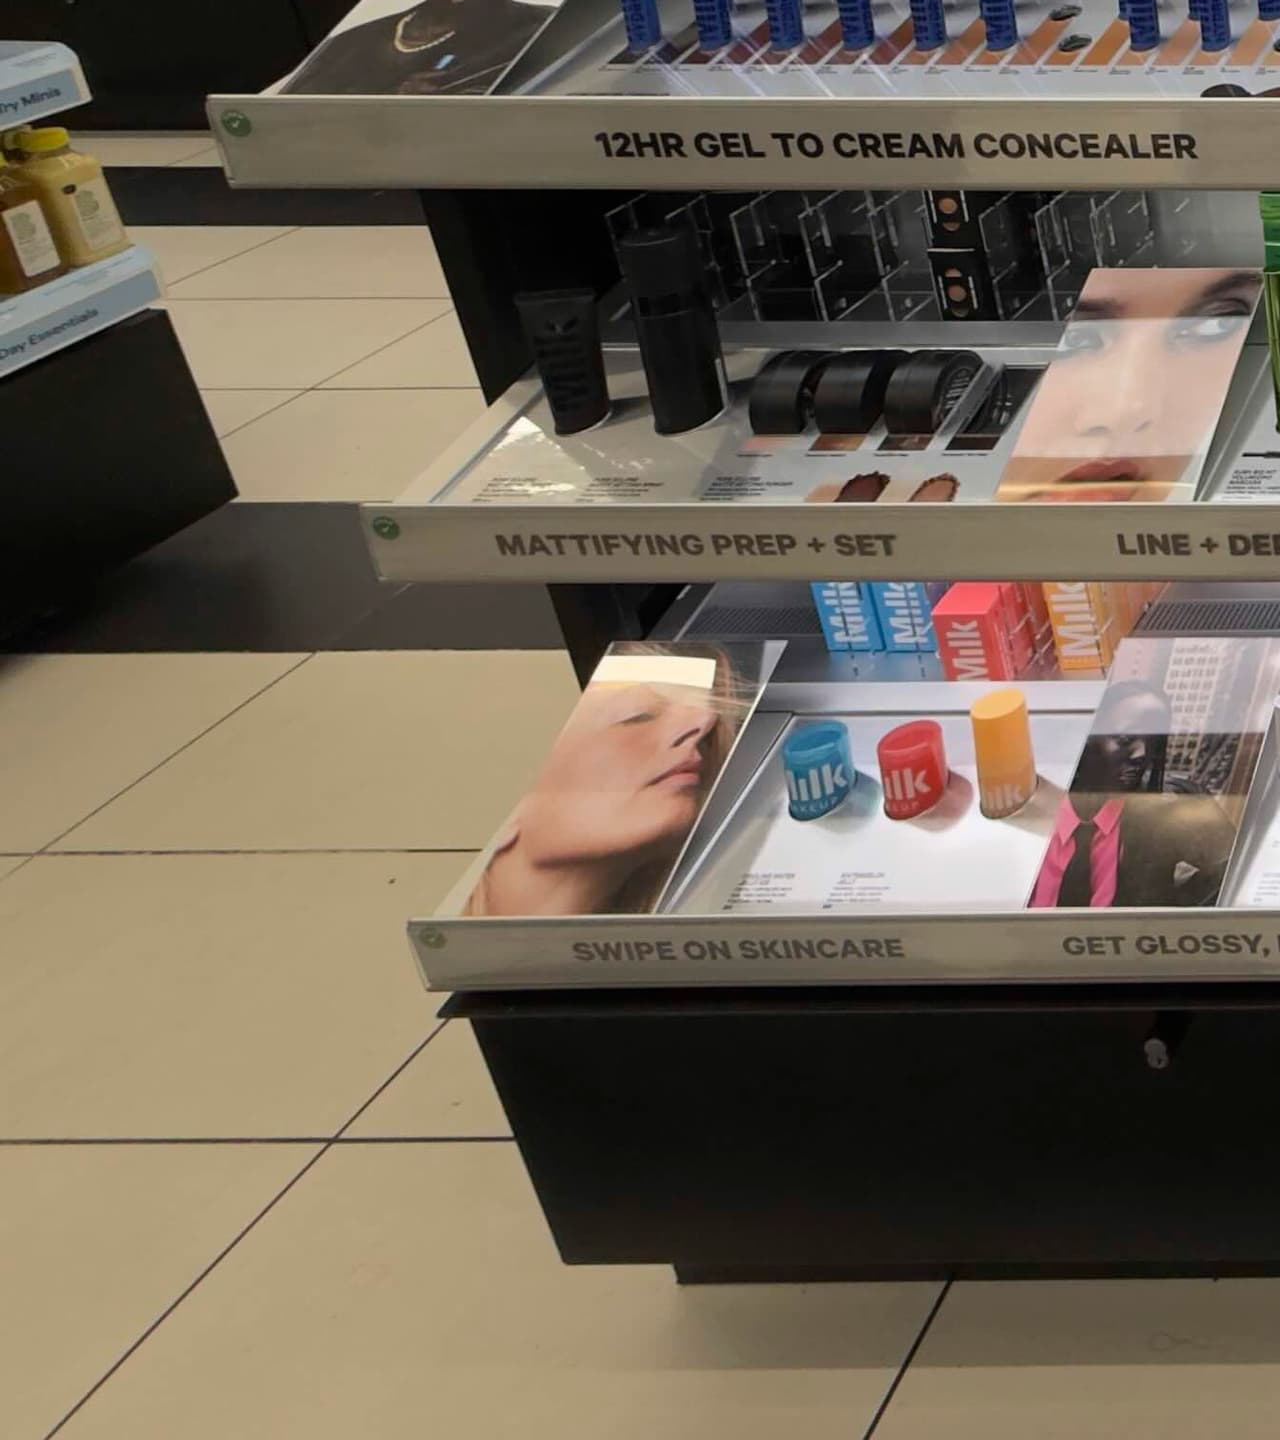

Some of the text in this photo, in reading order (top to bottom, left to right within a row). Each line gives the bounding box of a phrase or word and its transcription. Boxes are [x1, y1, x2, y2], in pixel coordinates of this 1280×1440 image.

[22, 86, 62, 108] Minis
[595, 131, 1199, 160] 12HR GEL TO CREAM CONCEALER
[28, 307, 99, 347] Essentials
[494, 534, 898, 557] MATTIFYING PREP + SET
[1116, 533, 1191, 556] LINE
[1199, 537, 1219, 553] +
[821, 581, 870, 644] Milk
[882, 581, 930, 646] Milk
[946, 619, 992, 682] Milk
[884, 767, 932, 801] ilk
[572, 937, 905, 962] SWIPE ON SKINCARE
[1062, 935, 1126, 956] GET
[1135, 933, 1271, 958] GLOSSY,
